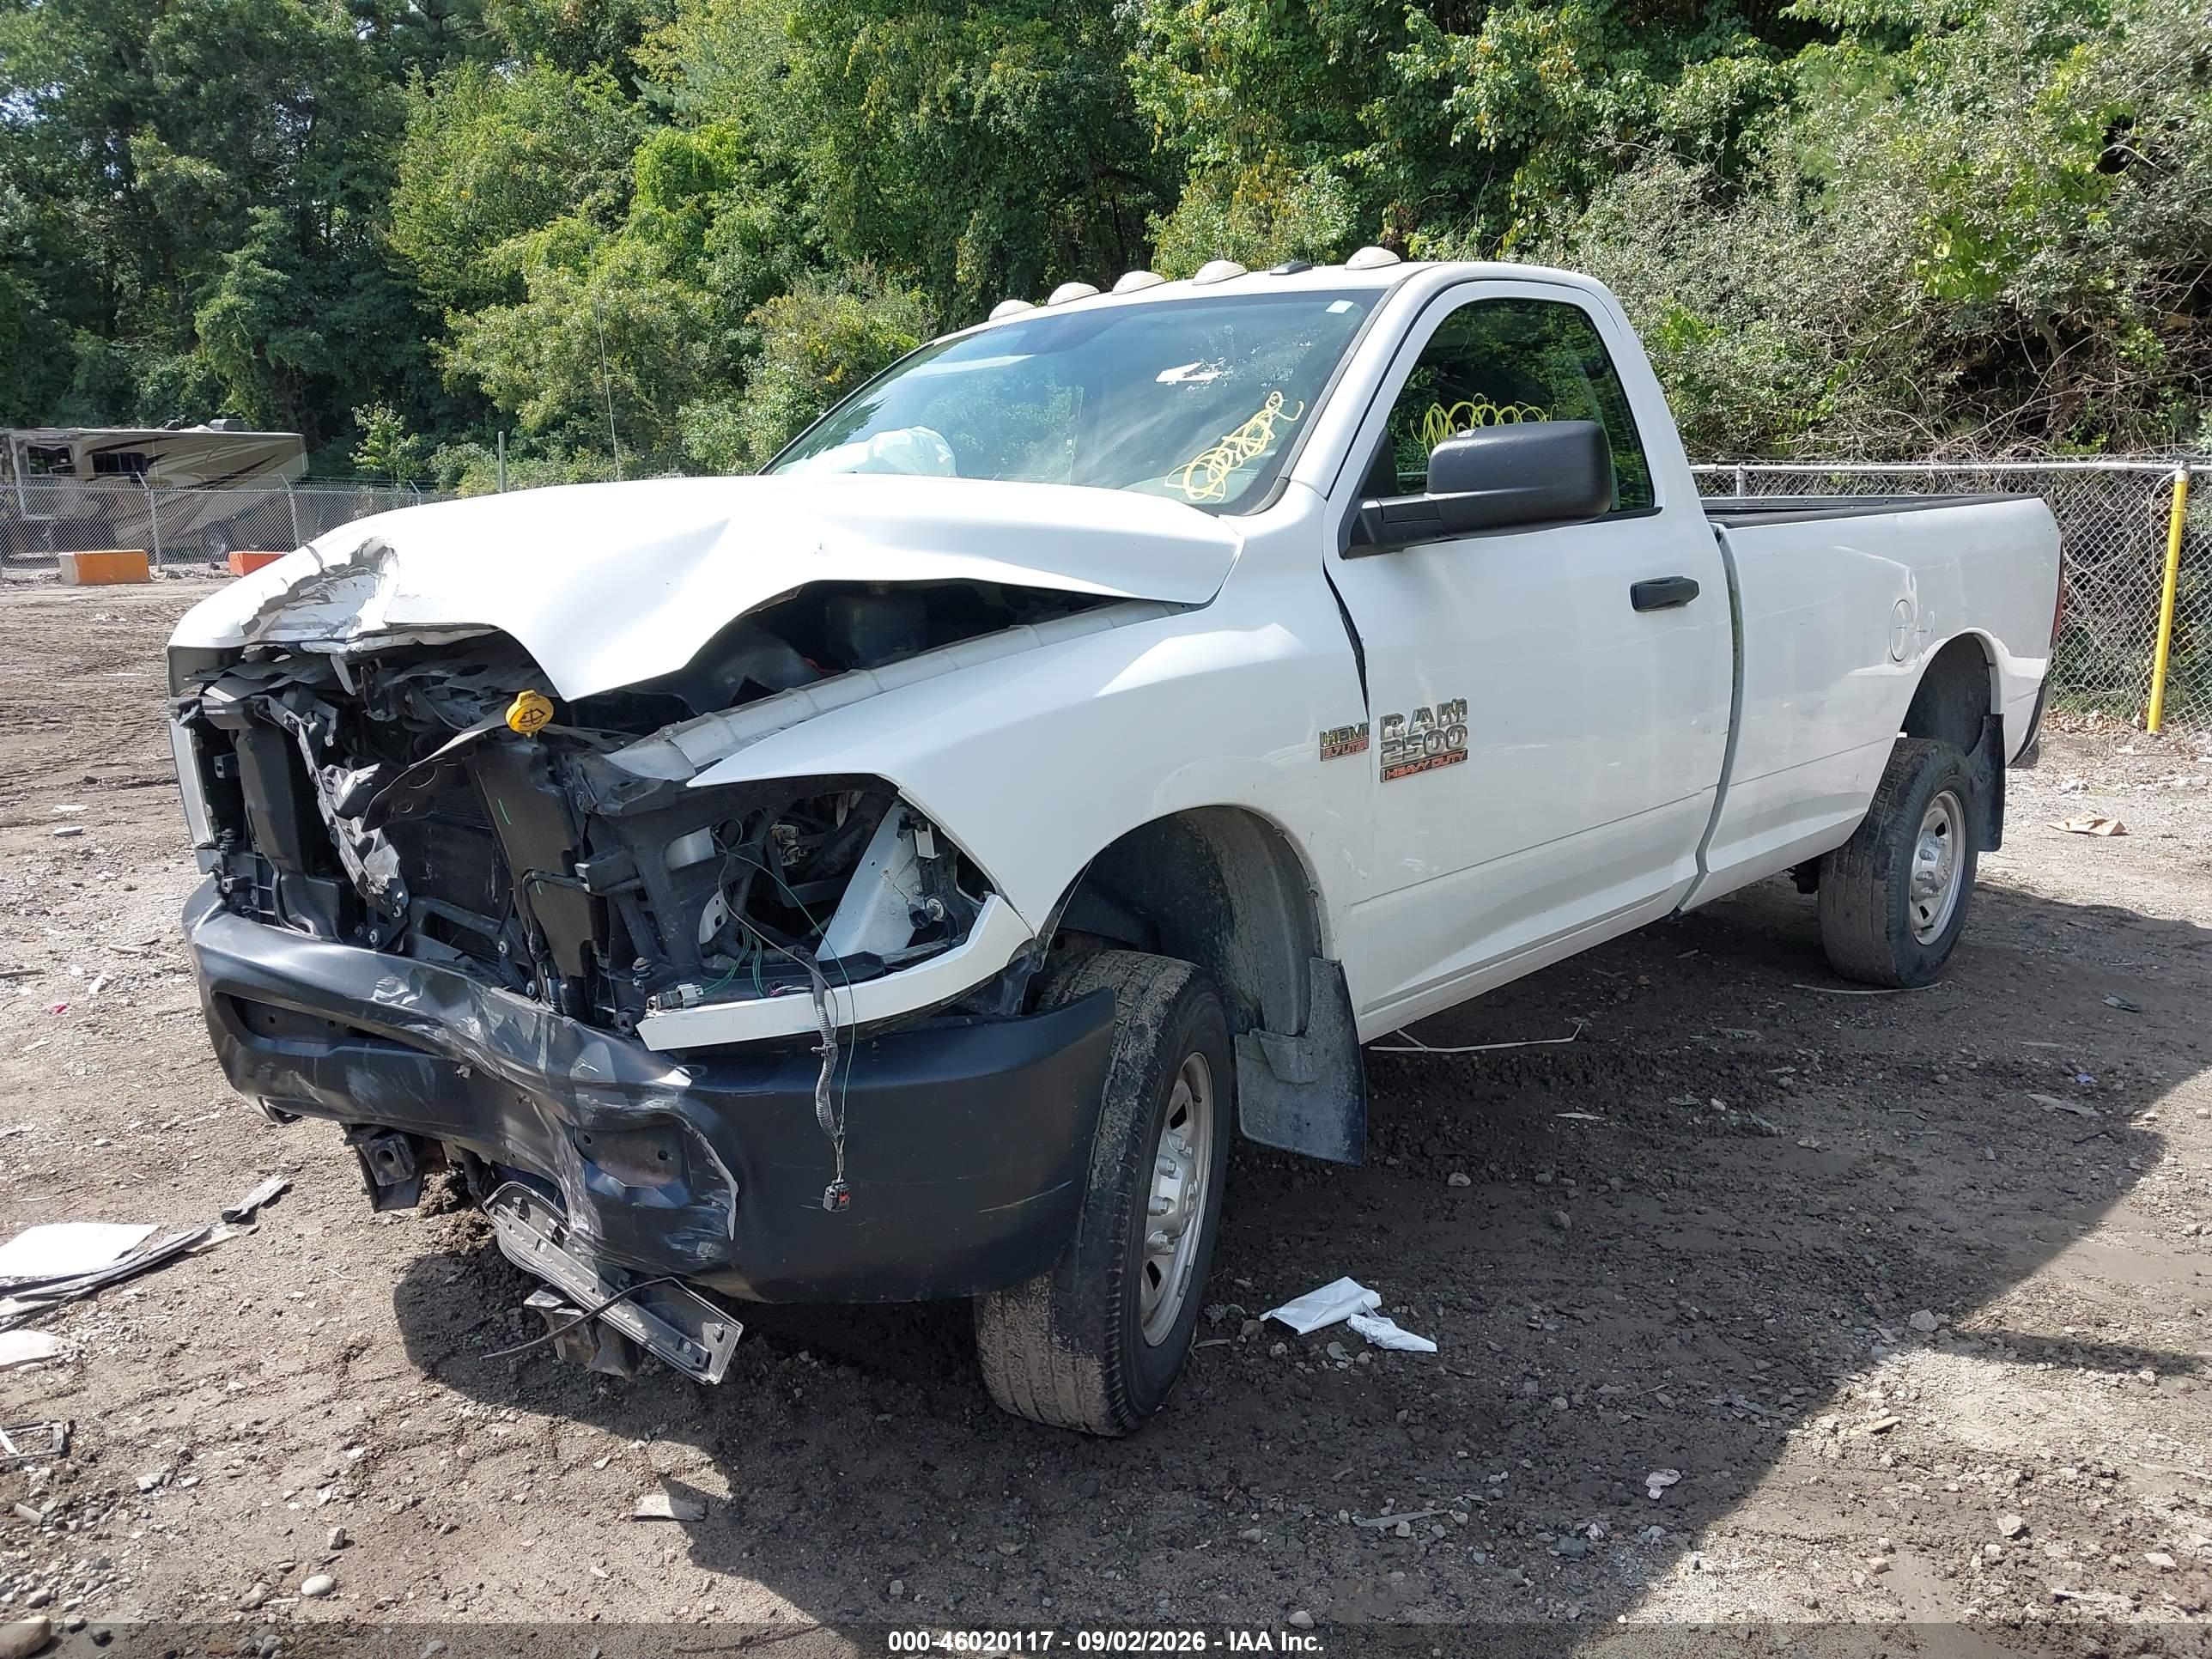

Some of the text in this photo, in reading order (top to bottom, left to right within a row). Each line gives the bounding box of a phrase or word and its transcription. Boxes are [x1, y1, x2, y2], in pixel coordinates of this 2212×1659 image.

[1380, 697, 1468, 741] RAM
[1380, 725, 1468, 766] 2500
[1387, 751, 1466, 780] HEAVY DUTY
